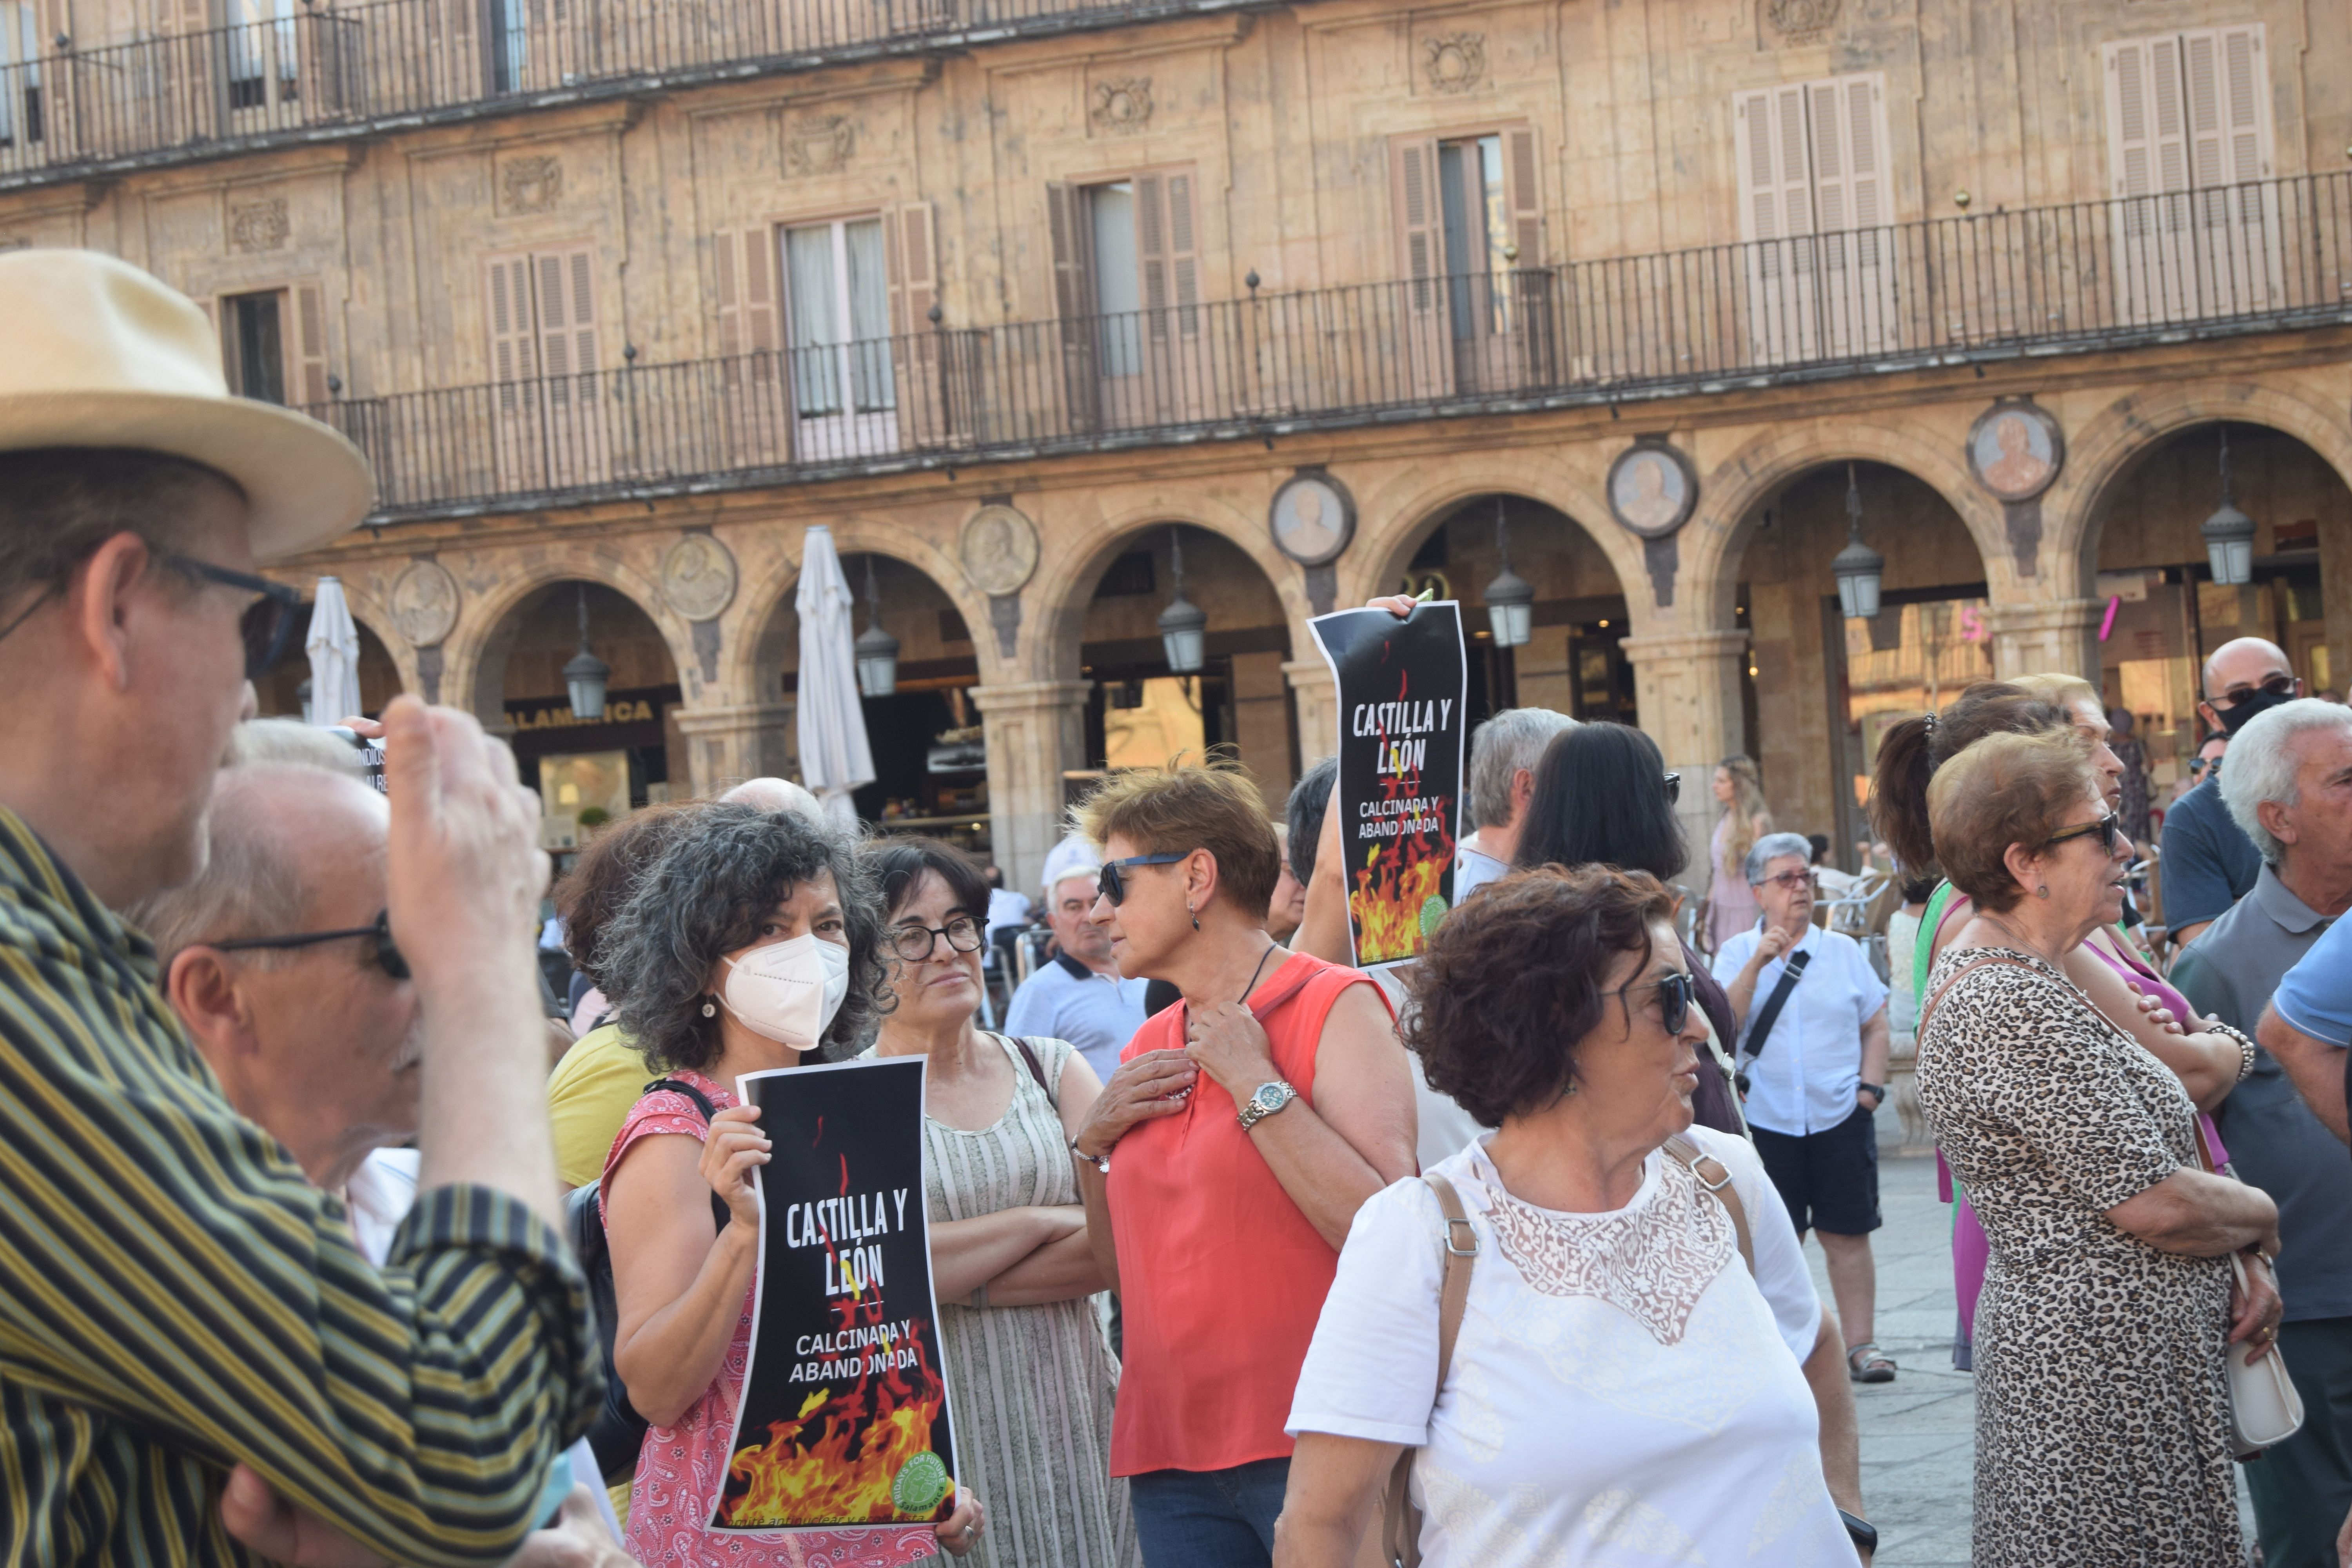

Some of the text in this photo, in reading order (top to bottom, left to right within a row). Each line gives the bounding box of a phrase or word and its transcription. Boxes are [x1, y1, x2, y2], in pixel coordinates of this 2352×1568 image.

[1353, 699, 1452, 737] CASTILLA Y
[1377, 733, 1426, 774] LEÓN
[1360, 796, 1439, 818] CALCINADA Y
[787, 1188, 908, 1248] CASTILLA Y
[826, 1237, 884, 1296] LEÓN
[796, 1319, 910, 1355] CALCINADA Y
[893, 1454, 945, 1504] FRIDAYS FOR FUTURE
[900, 1486, 944, 1512] Salamanca
[724, 1515, 764, 1526] omité
